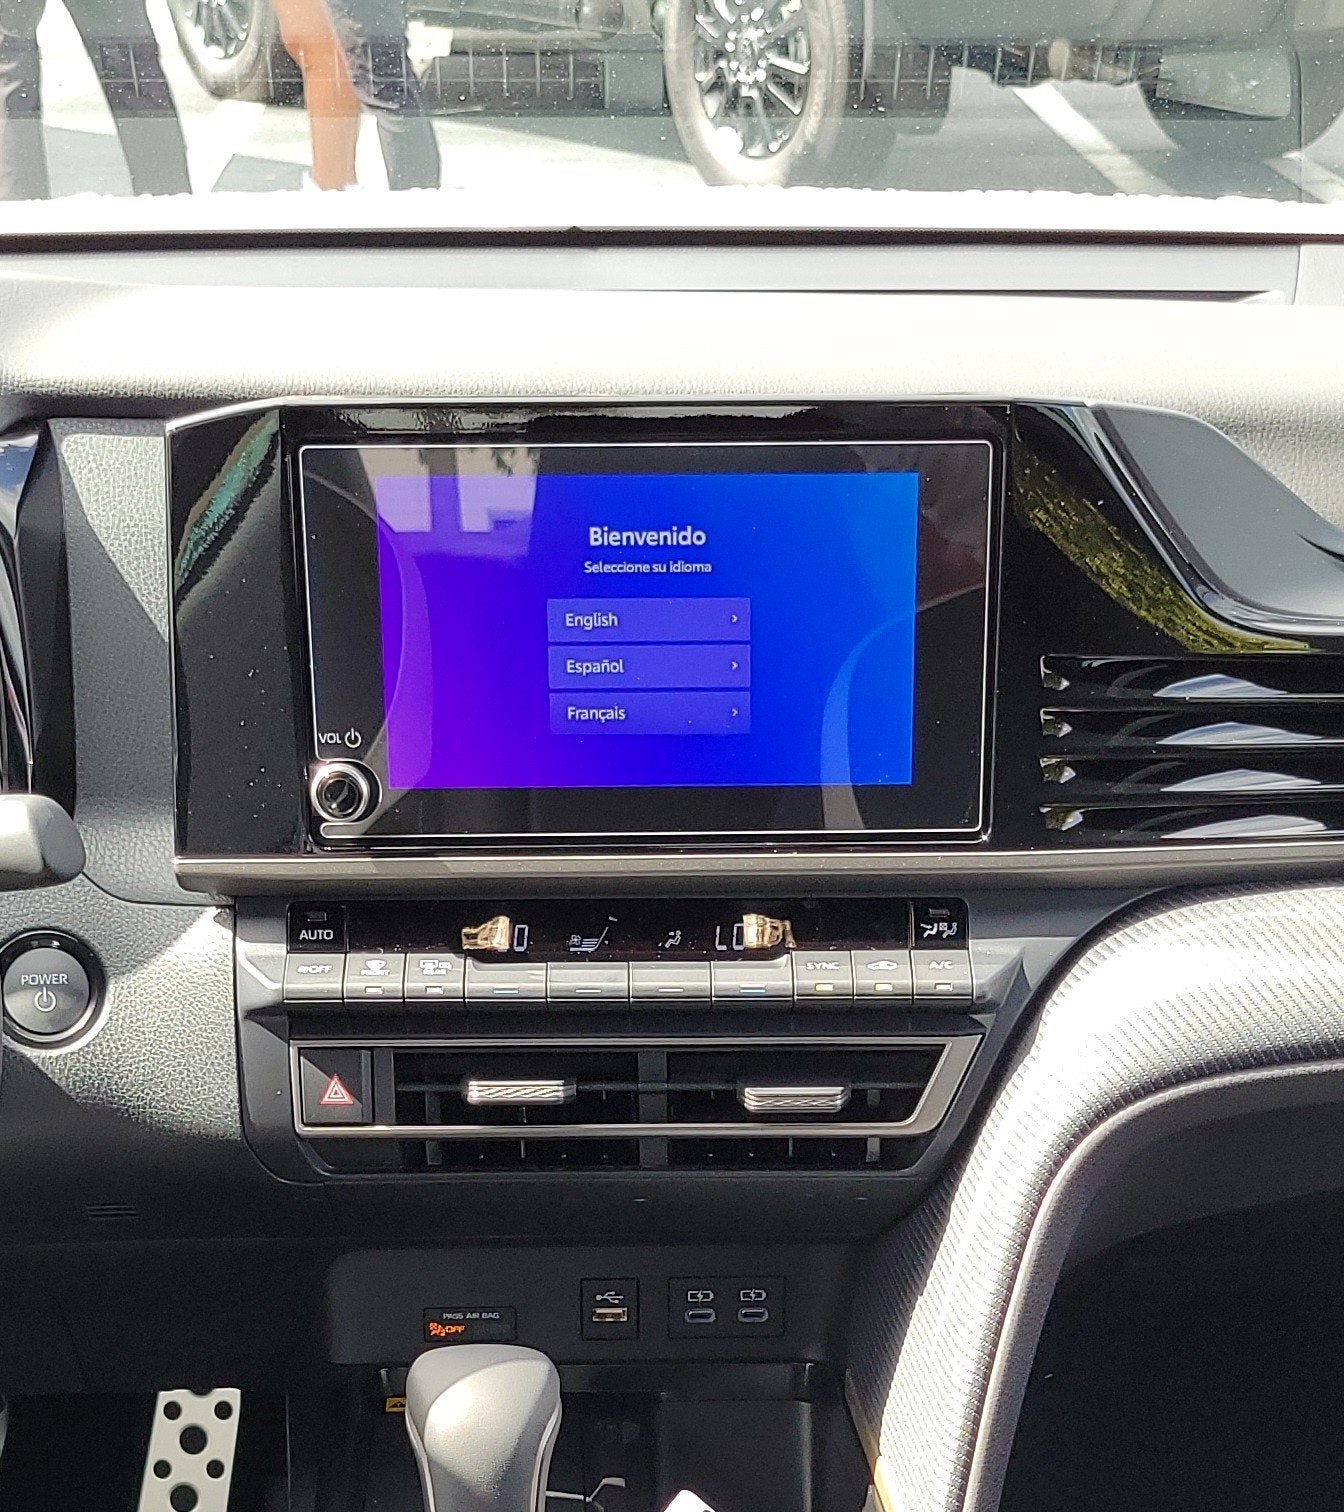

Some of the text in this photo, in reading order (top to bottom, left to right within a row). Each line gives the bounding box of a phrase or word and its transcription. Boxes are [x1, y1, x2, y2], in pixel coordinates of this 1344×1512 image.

[588, 525, 706, 546] Bienvenido
[583, 560, 712, 573] Seleccione su idioma
[565, 612, 618, 630] English
[566, 659, 624, 676] Español
[567, 706, 626, 723] Français
[318, 732, 342, 744] VOL
[299, 929, 334, 940] AUTO
[806, 961, 840, 970] SYNC
[929, 961, 953, 970] A/C
[21, 973, 69, 986] POWER
[442, 1312, 464, 1320] PASS
[445, 1325, 466, 1334] OFF
